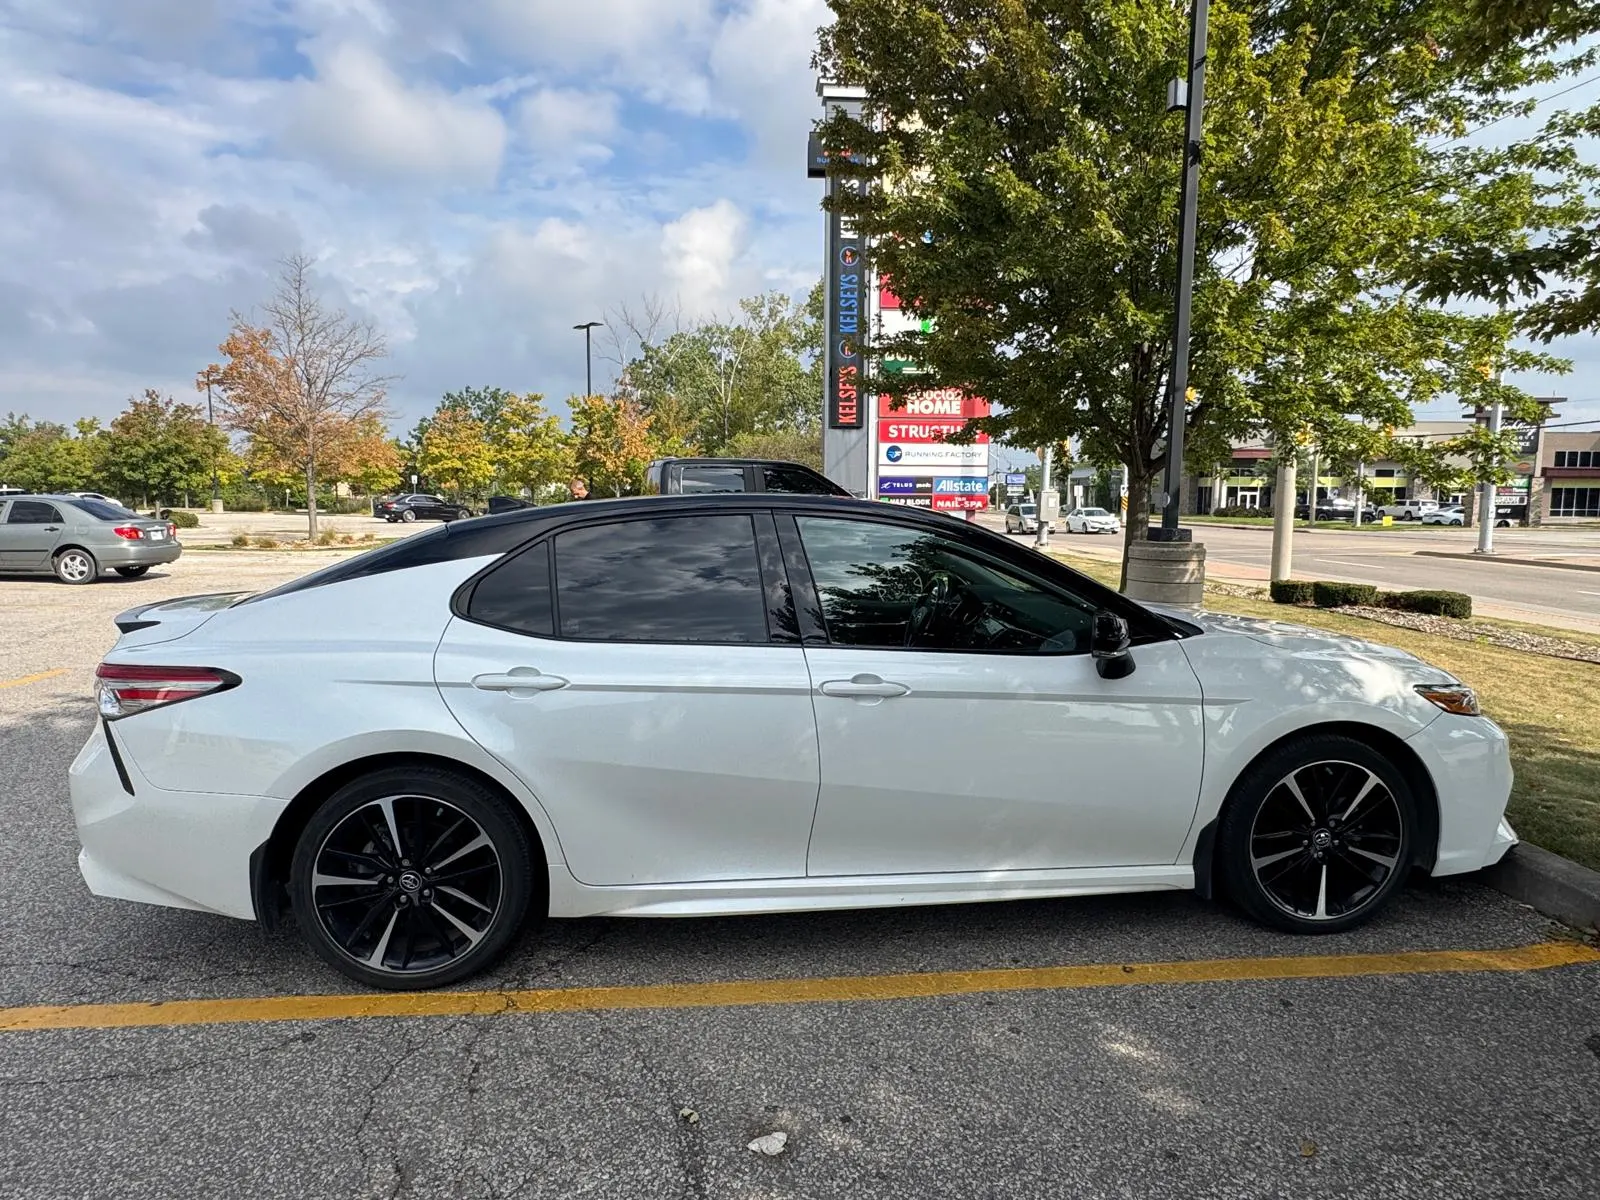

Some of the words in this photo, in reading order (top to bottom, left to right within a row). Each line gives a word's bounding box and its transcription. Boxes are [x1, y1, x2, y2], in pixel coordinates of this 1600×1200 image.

[839, 274, 858, 333] KELSEYS
[907, 400, 961, 415] HOME
[936, 479, 983, 492] Allstate
